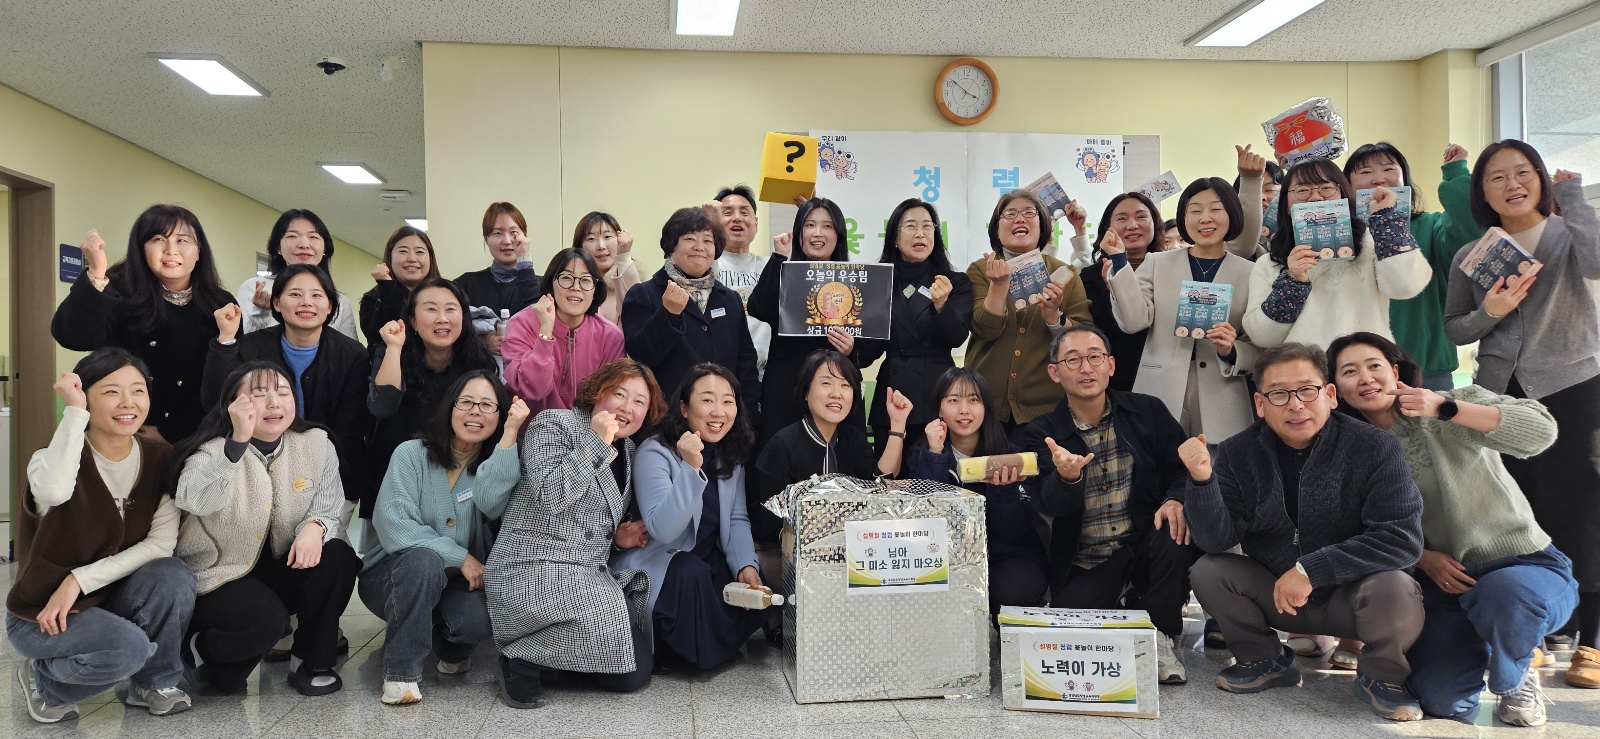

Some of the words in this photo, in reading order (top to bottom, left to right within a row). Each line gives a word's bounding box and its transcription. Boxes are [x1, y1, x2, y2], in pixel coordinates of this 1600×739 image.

[1289, 129, 1305, 146] 福
[913, 166, 940, 202] 청
[806, 269, 835, 281] 오늘의
[838, 270, 868, 283] 우승팀
[807, 326, 822, 335] 상금
[888, 547, 908, 558] 님아
[856, 561, 865, 571] 그
[869, 560, 887, 570] 미소
[891, 559, 910, 569] 잃지
[914, 558, 943, 568] 마오상
[1041, 660, 1084, 676] 노력이
[1092, 662, 1121, 677] 가상
